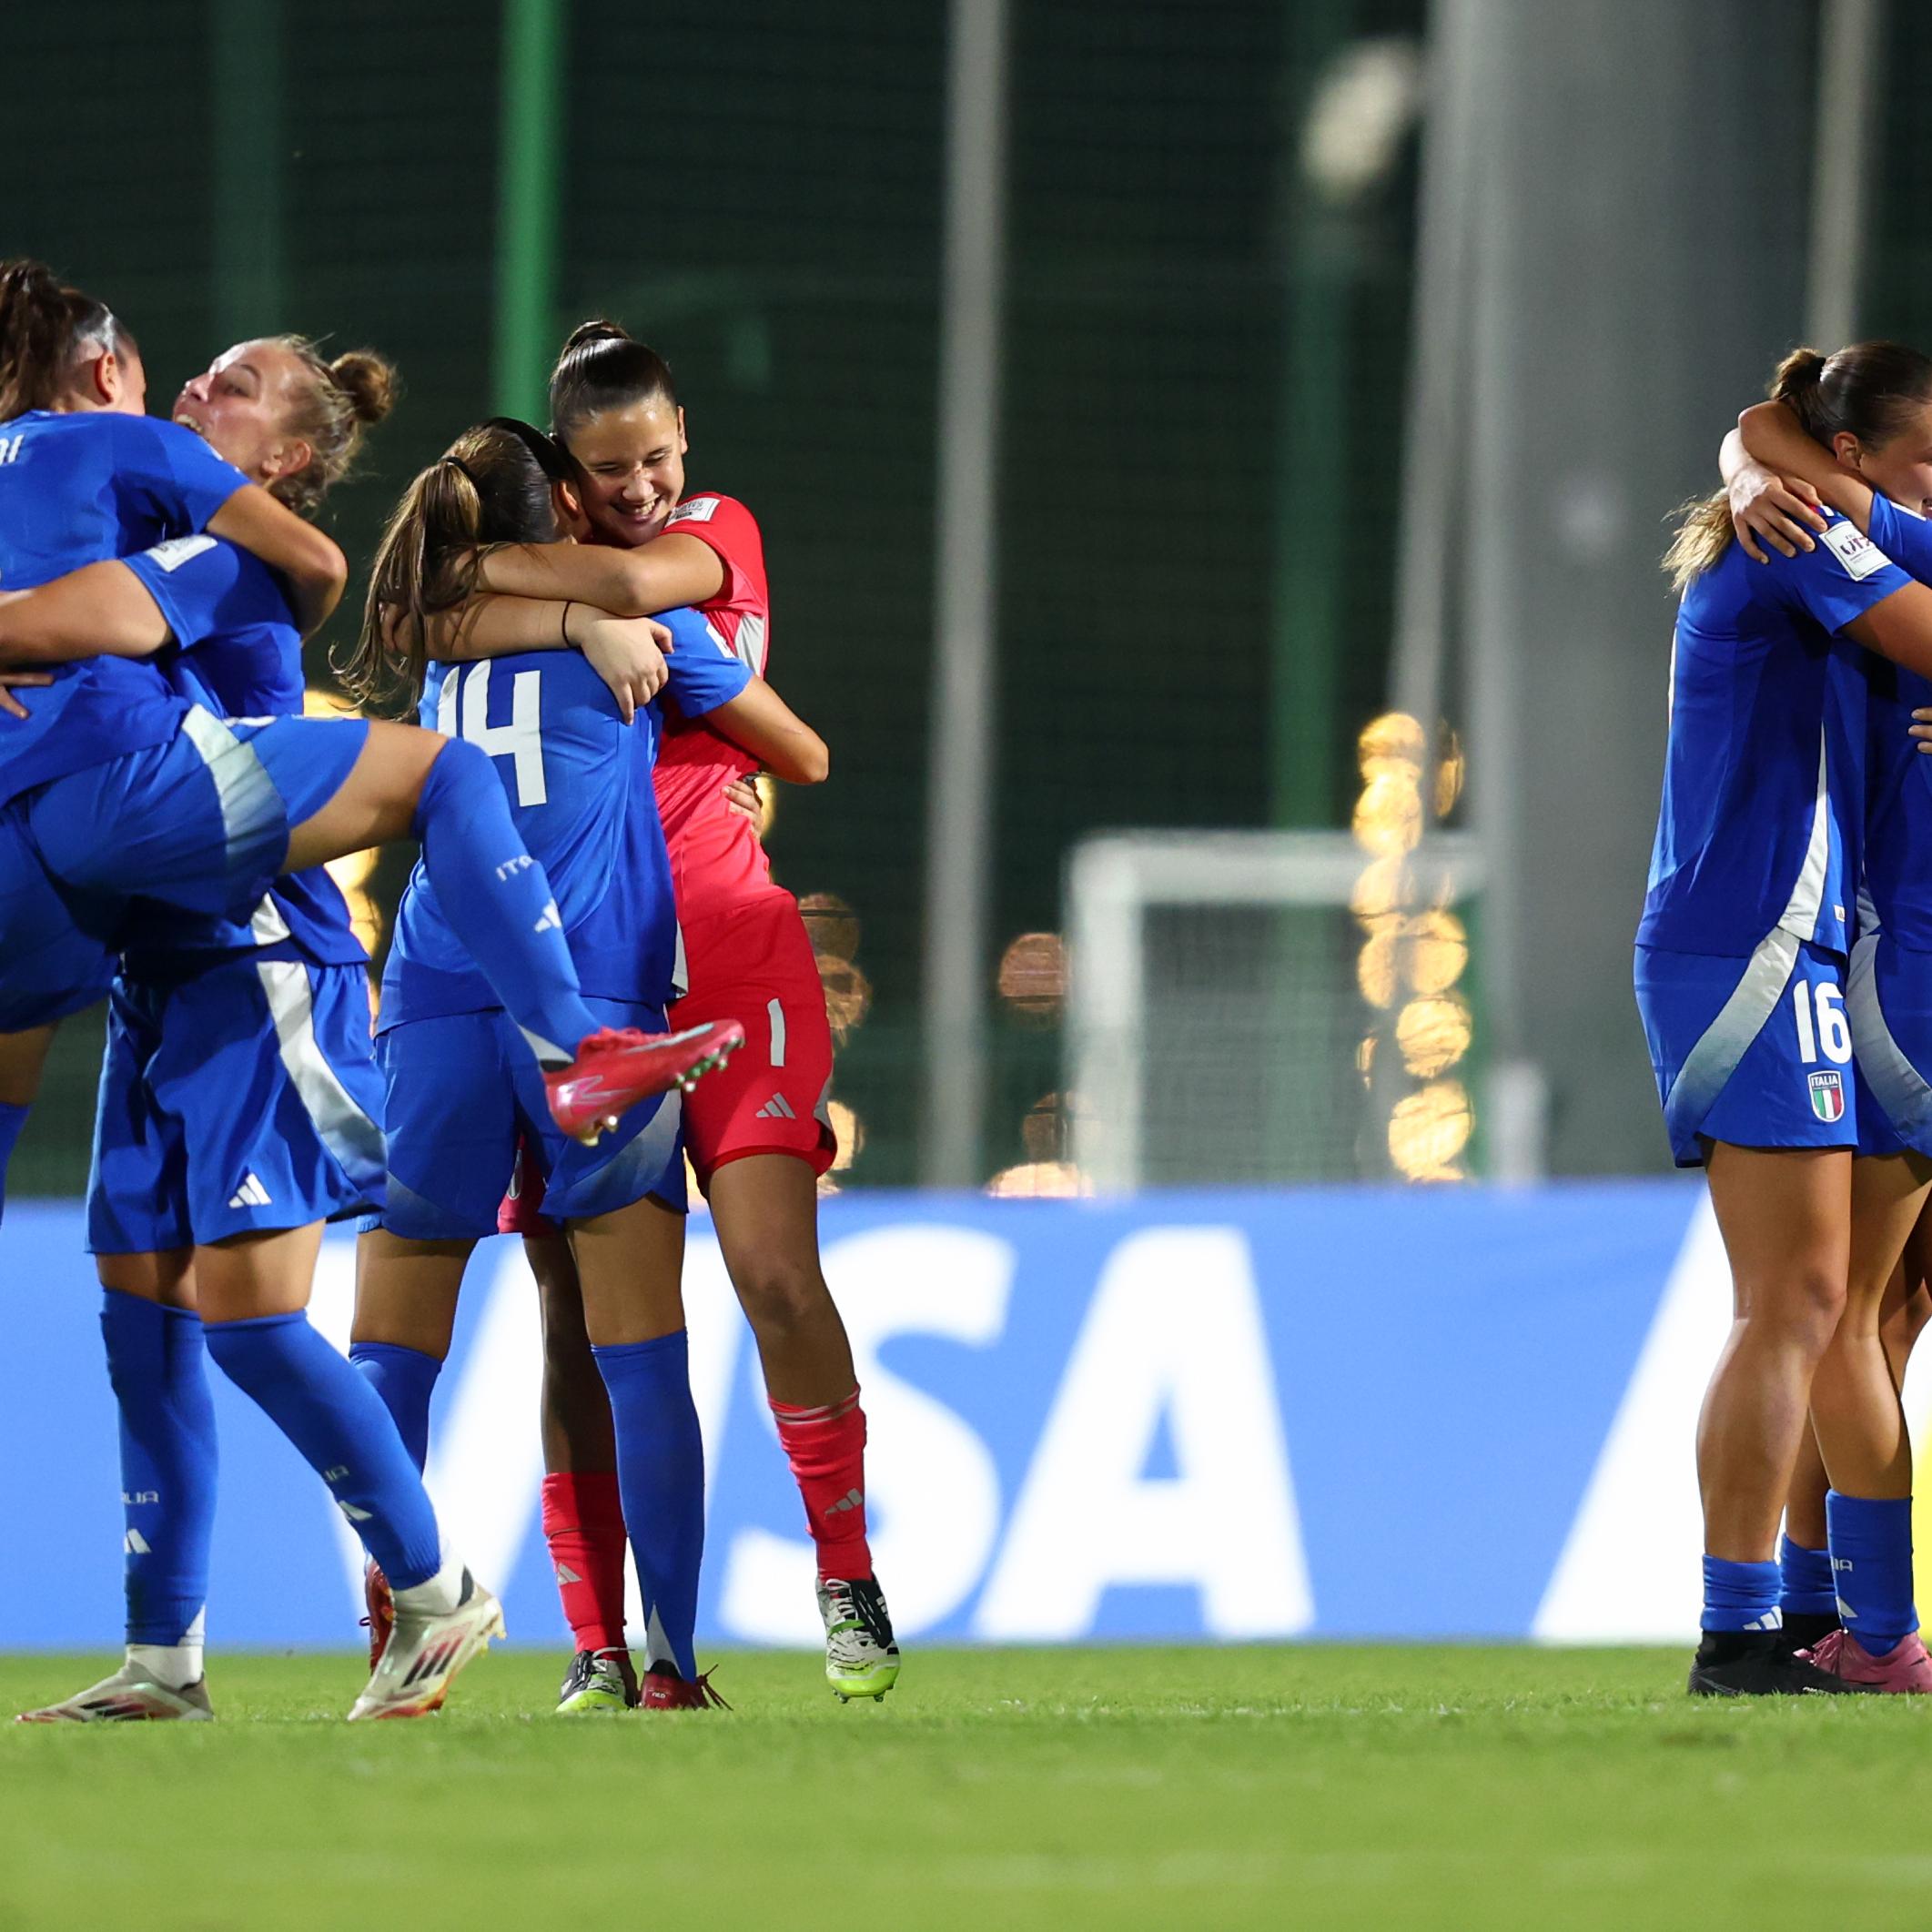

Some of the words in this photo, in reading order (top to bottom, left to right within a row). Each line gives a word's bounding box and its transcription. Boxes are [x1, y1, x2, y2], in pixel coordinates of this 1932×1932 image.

[437, 658, 547, 807] 14
[766, 997, 786, 1067] 1
[1793, 979, 1853, 1064] 16
[1811, 1075, 1838, 1087] ITALIA
